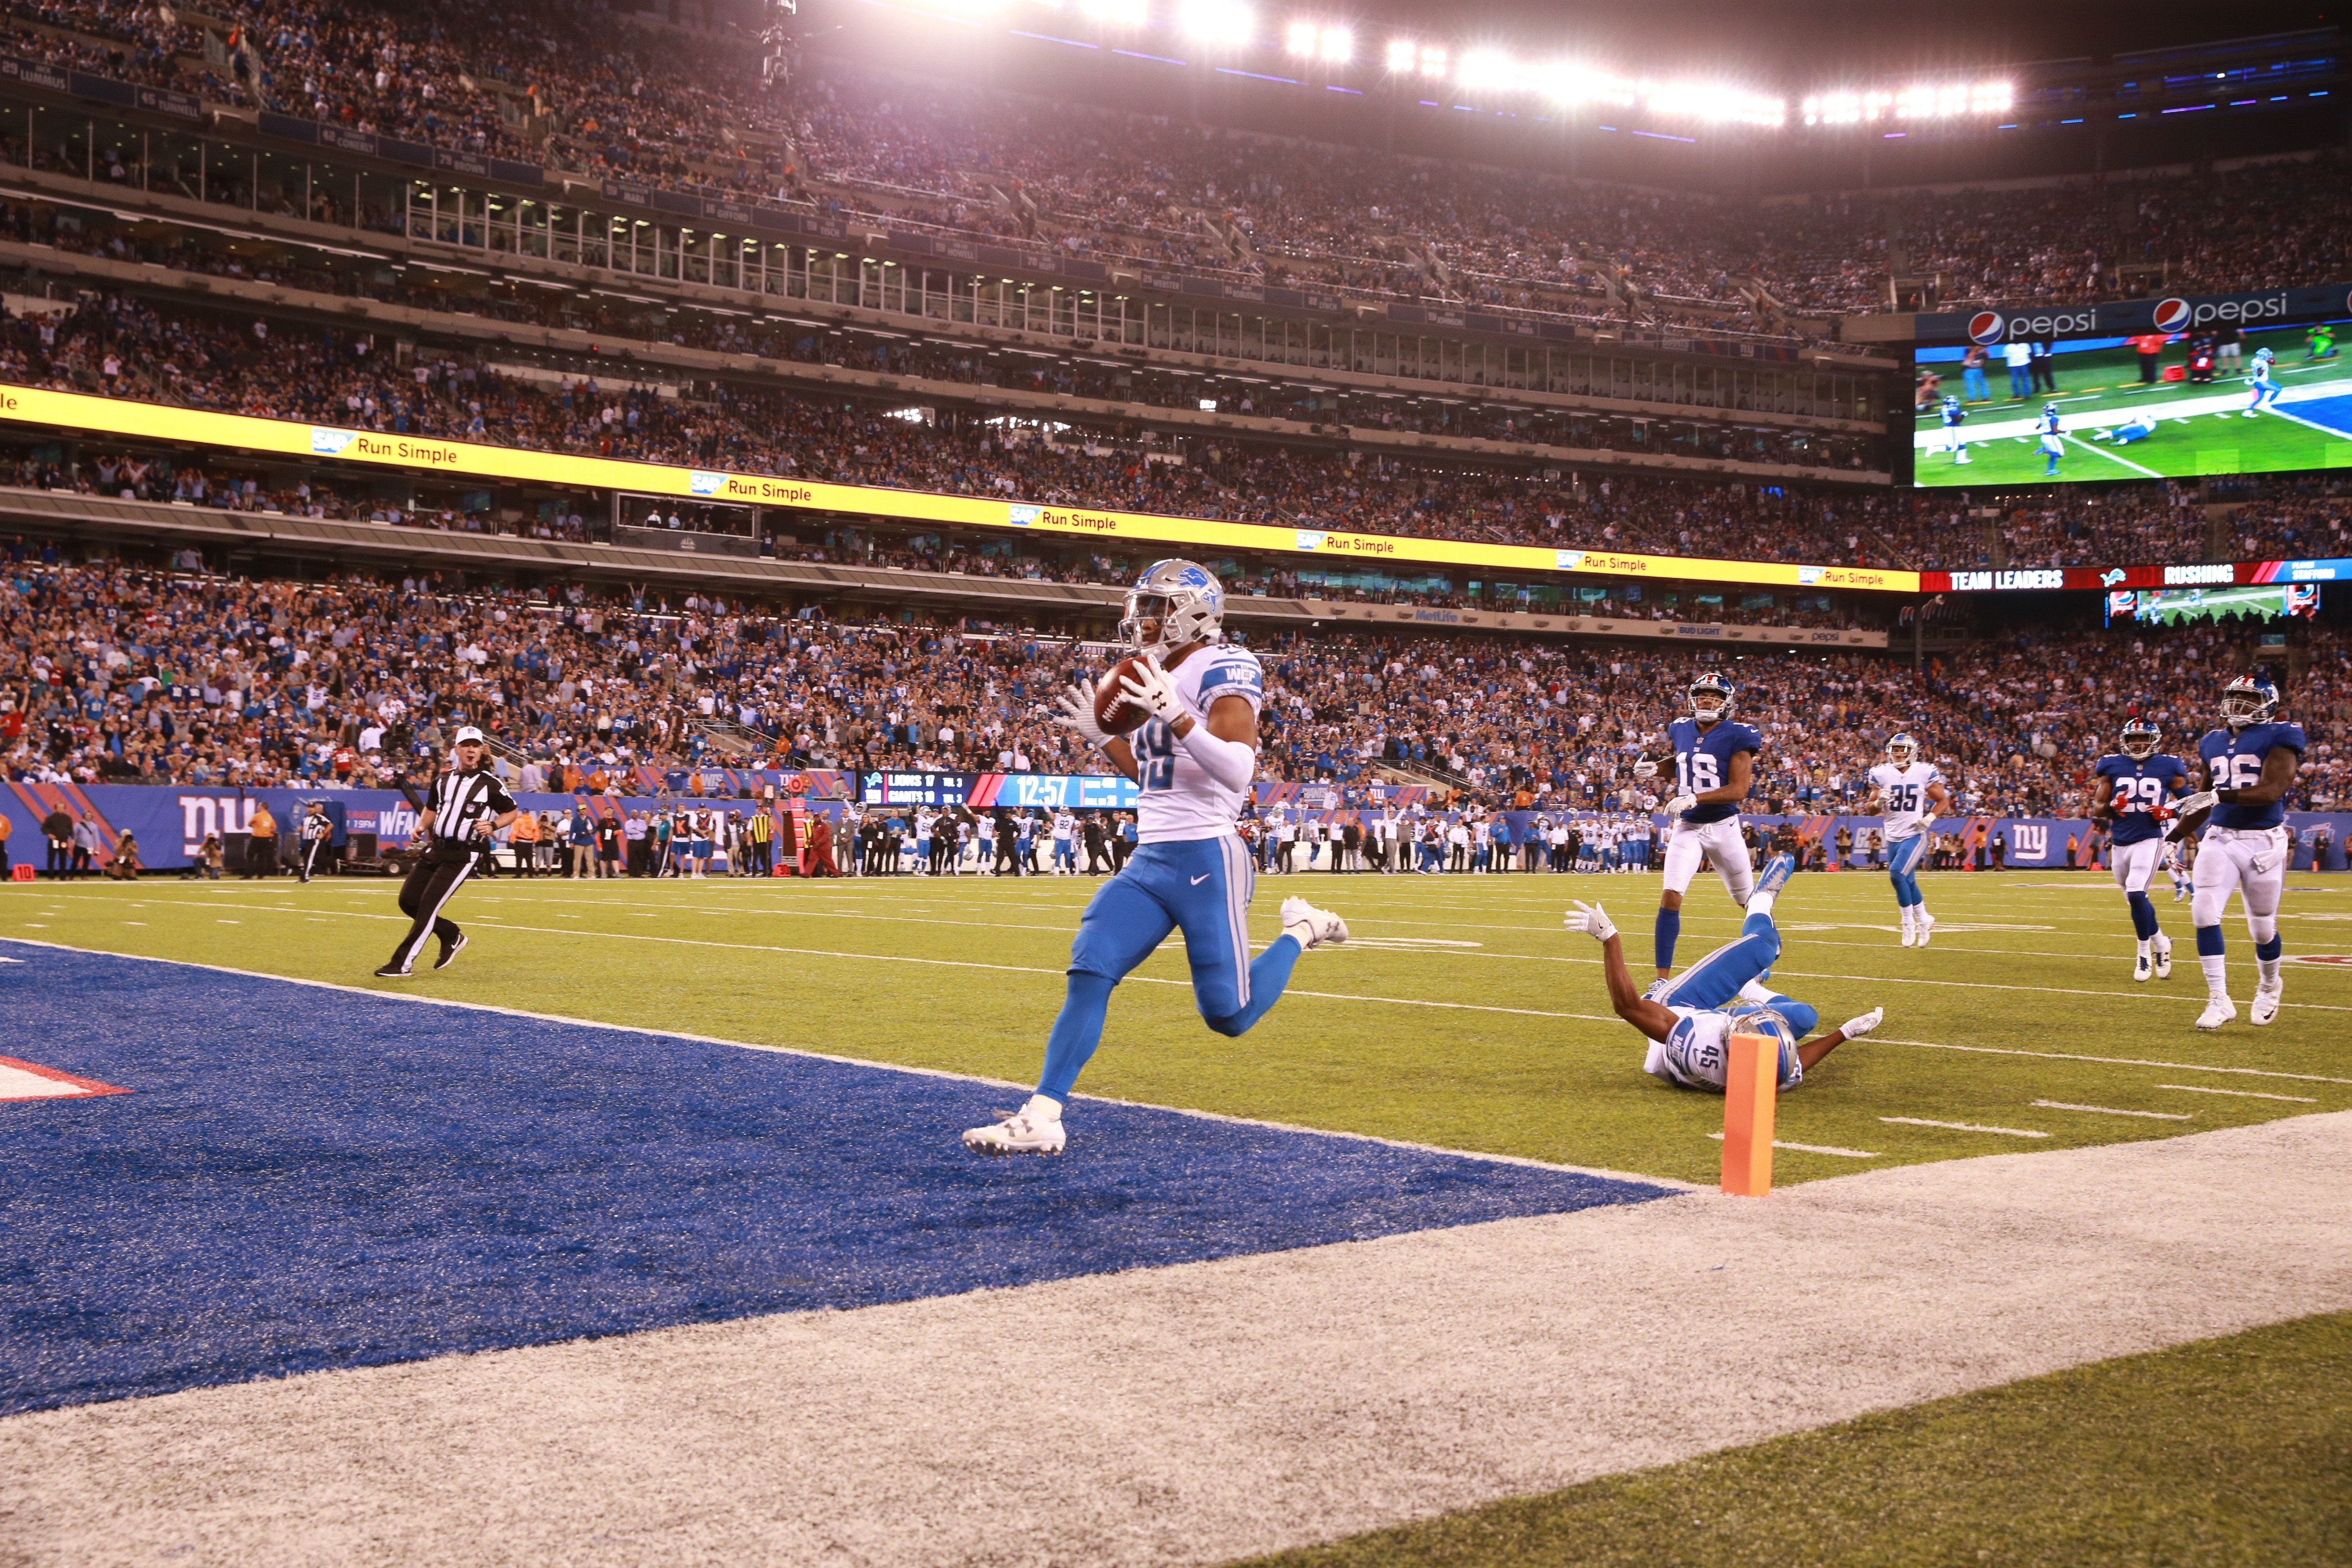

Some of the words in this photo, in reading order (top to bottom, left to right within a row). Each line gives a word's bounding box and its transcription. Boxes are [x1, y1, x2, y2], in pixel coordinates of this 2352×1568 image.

[2, 60, 18, 75] 29
[20, 69, 66, 90] LUMMUS
[159, 99, 198, 118] TUNNELL
[2194, 292, 2287, 328] pepsi
[2009, 308, 2096, 340] pepsi
[358, 438, 392, 455] Run
[398, 443, 457, 464] Simple
[729, 480, 757, 495] Run
[762, 484, 812, 502] Simple
[1043, 512, 1067, 525] Run
[1072, 514, 1117, 531] Simple
[1327, 537, 1349, 549] Run
[1354, 539, 1394, 554] Simple
[1585, 556, 1605, 568] Run
[1610, 558, 1646, 572] Simple
[1825, 572, 1845, 582] Run
[1848, 573, 1884, 586] Simple
[1949, 571, 1992, 590] TEAM
[1995, 569, 2063, 589] LEADERS
[2164, 564, 2234, 585] RUSHING
[2292, 568, 2335, 580] STAFFORD
[1416, 609, 1458, 622] MetLife
[1812, 632, 1839, 642] pepsi
[1225, 667, 1256, 682] WCF
[336, 753, 349, 763] 22
[2210, 754, 2262, 790] 26
[888, 774, 922, 787] LIONS
[925, 775, 935, 787] 17
[956, 778, 963, 788] 3
[888, 790, 923, 803] GIANTS
[956, 794, 963, 804] 3
[1016, 775, 1068, 806] 12:57
[2116, 777, 2162, 813] 29
[676, 820, 687, 834] K
[1059, 820, 1069, 830] 92
[2013, 823, 2048, 861] ny
[18, 866, 30, 879] 10
[779, 864, 790, 875] 30
[1700, 1045, 1719, 1069] 45
